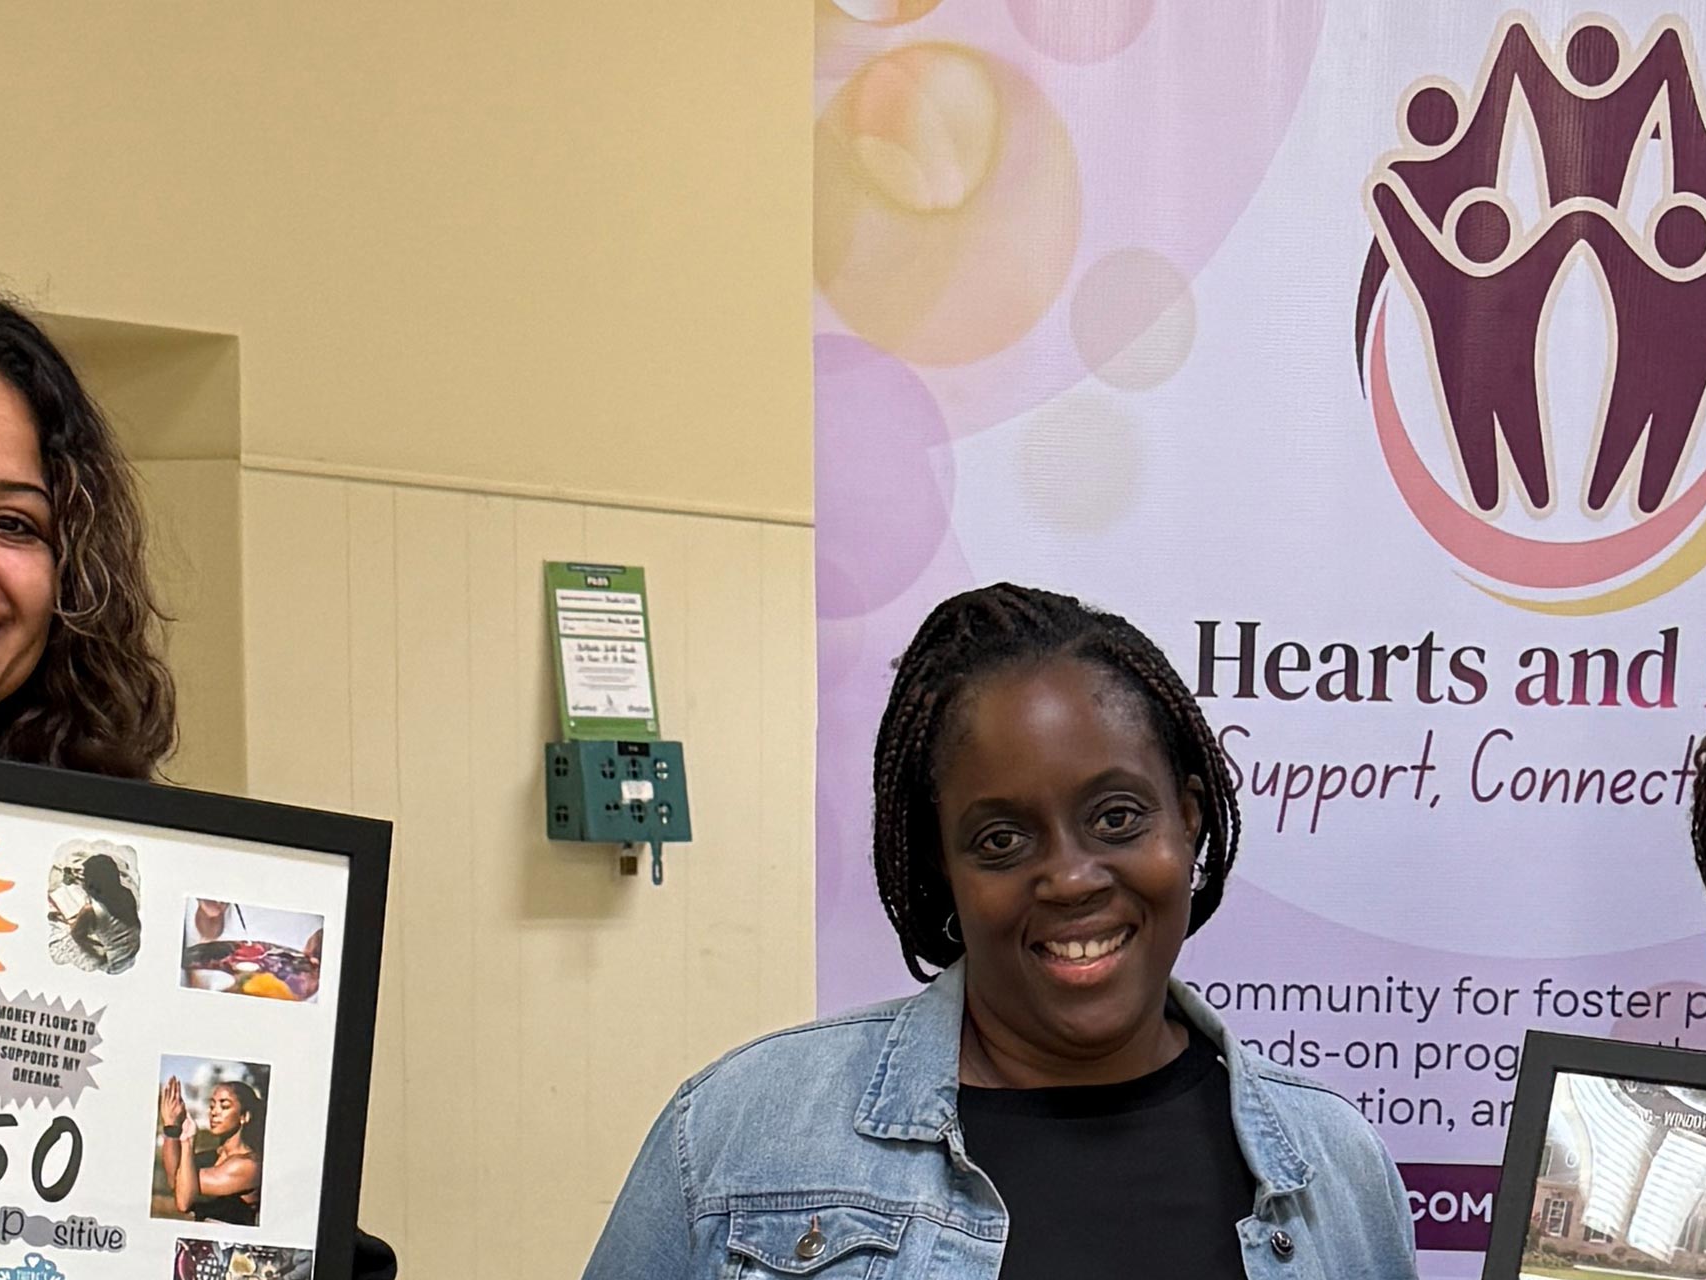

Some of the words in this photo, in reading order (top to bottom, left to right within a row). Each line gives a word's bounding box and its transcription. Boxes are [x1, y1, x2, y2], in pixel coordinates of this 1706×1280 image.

[1193, 620, 1488, 705] Hearts
[1515, 627, 1680, 709] and
[1217, 724, 1441, 834] Support,
[1472, 727, 1697, 806] Connect
[1454, 976, 1514, 1017] for
[1534, 979, 1671, 1020] foster
[0, 1025, 17, 1041] ME
[21, 1029, 60, 1050] EASILY
[64, 1038, 87, 1053] AND
[40, 1013, 78, 1031] FLOWS
[83, 1022, 96, 1035] TO
[0, 1046, 59, 1068] SUPPORTS
[62, 1056, 81, 1072] MY
[1414, 1042, 1520, 1081] prog
